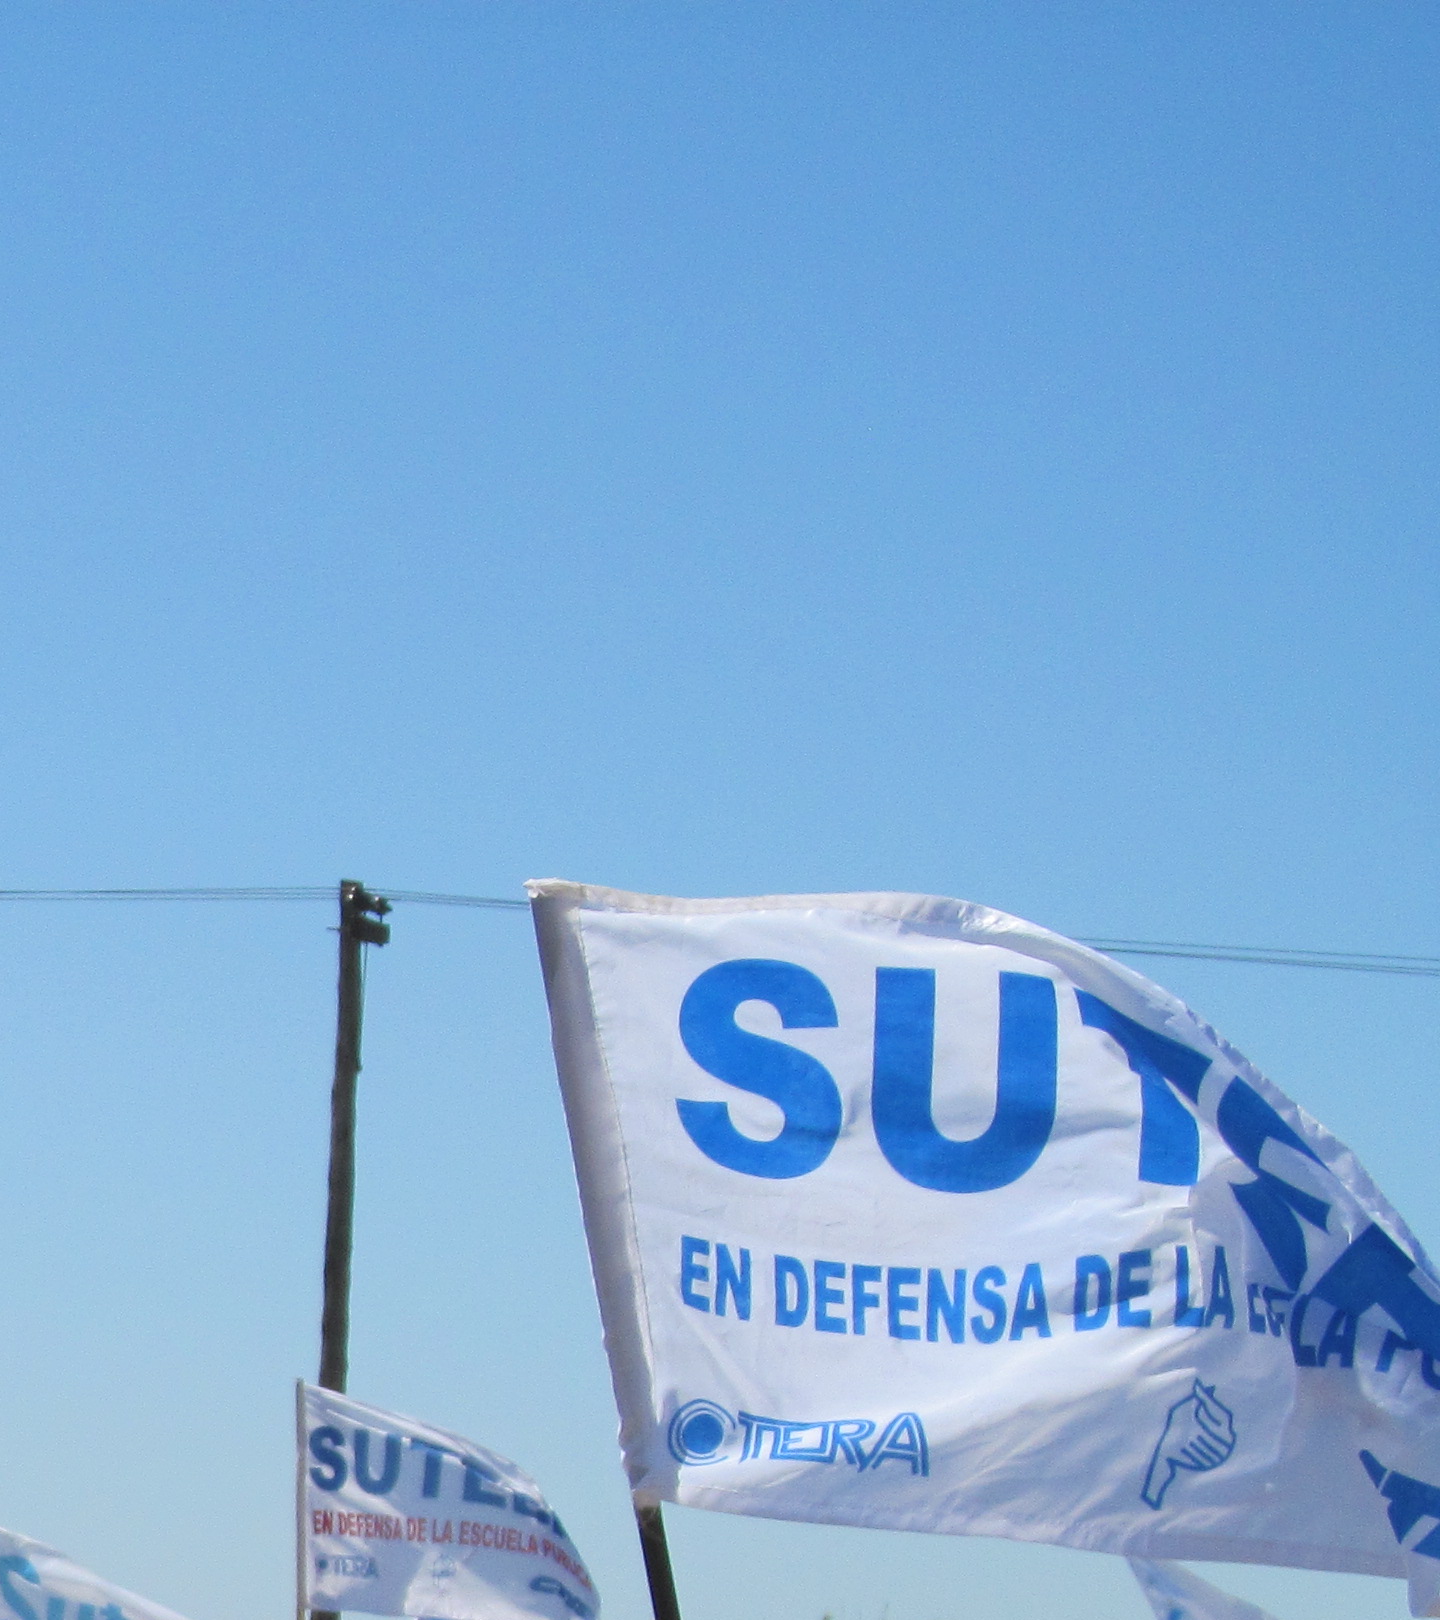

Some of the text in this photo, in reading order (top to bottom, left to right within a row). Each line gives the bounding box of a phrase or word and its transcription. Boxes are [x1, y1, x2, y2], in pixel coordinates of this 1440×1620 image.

[679, 1233, 753, 1321] EN
[773, 1253, 1052, 1347] DEFENSA
[1072, 1248, 1153, 1334] DE
[1174, 1244, 1235, 1330] LA
[311, 1509, 334, 1535] EN
[338, 1511, 403, 1541] DEFENSA
[407, 1517, 428, 1544] DE
[432, 1518, 454, 1545] LA
[458, 1520, 540, 1556] ESCUELA
